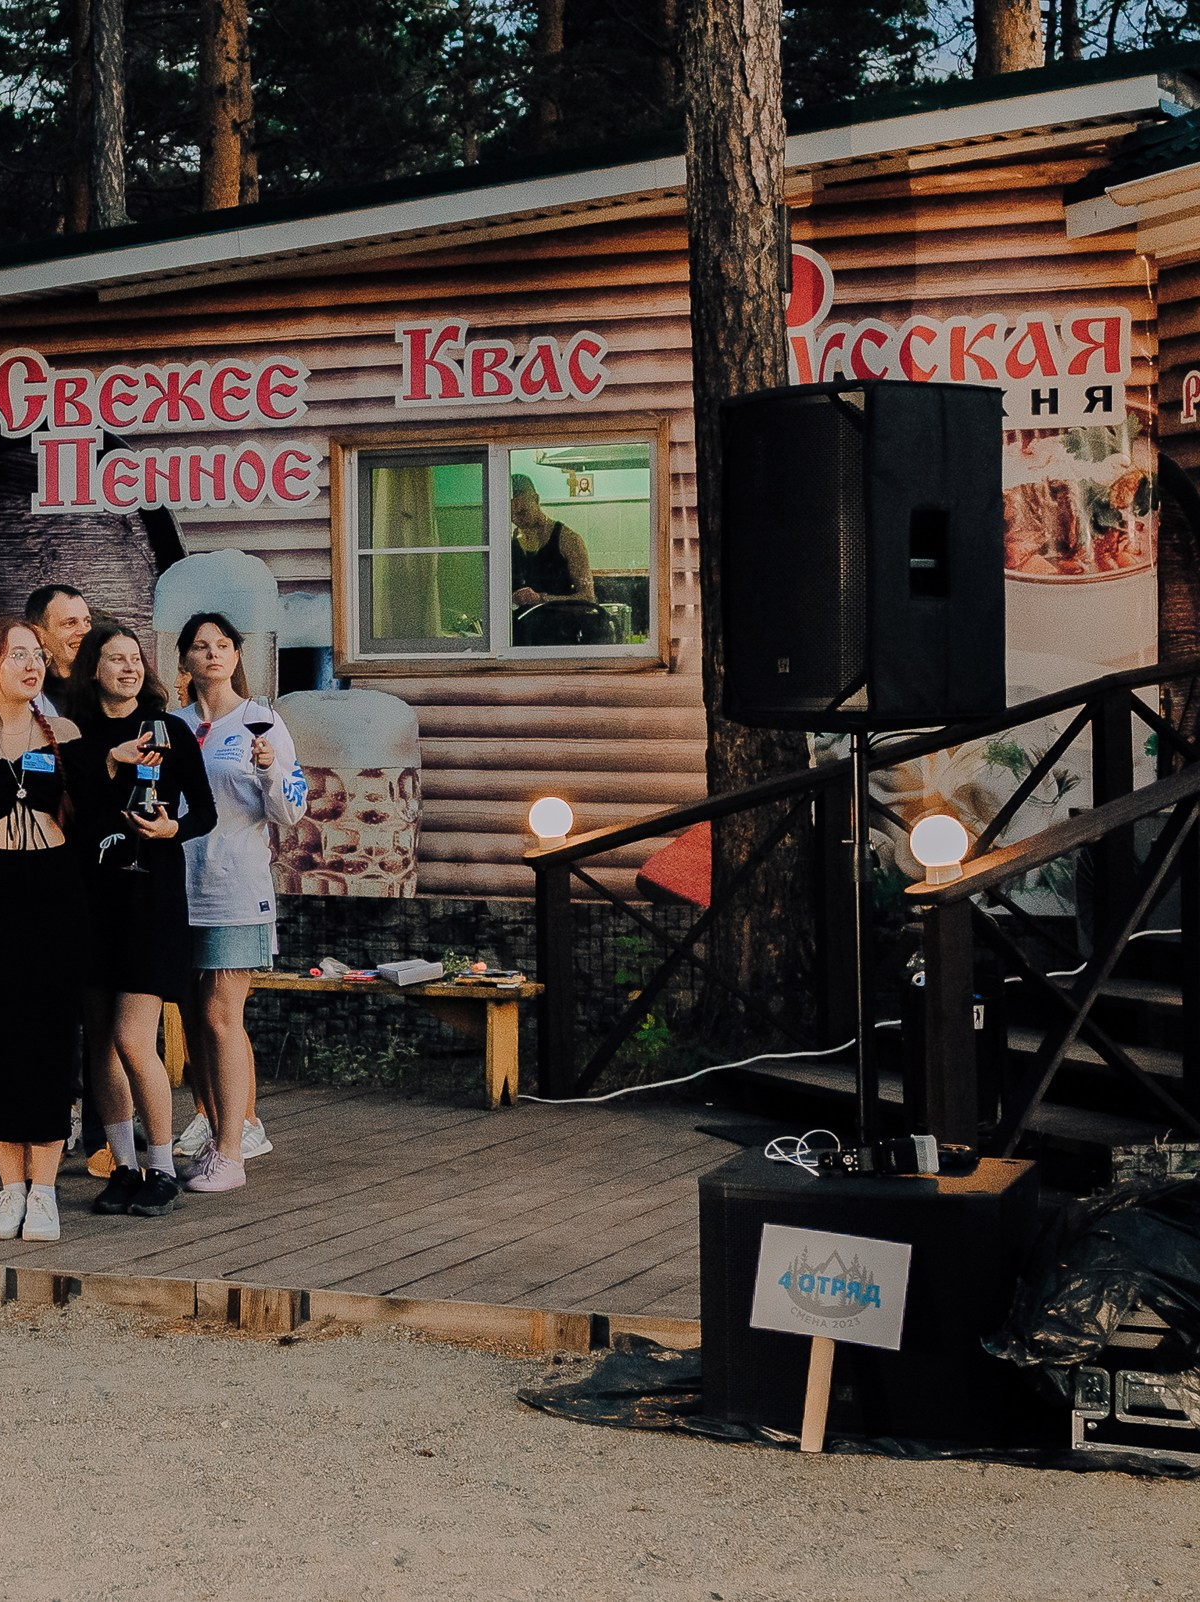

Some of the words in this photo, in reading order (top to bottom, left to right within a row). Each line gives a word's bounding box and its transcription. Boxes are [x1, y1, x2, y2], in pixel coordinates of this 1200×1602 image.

[402, 325, 602, 401] Квас
[37, 436, 312, 507] Пенное
[778, 1270, 793, 1290] 4
[798, 1273, 882, 1309] ОТРЯД
[790, 1306, 828, 1329] СМЕНА
[832, 1316, 862, 1329] 2023
